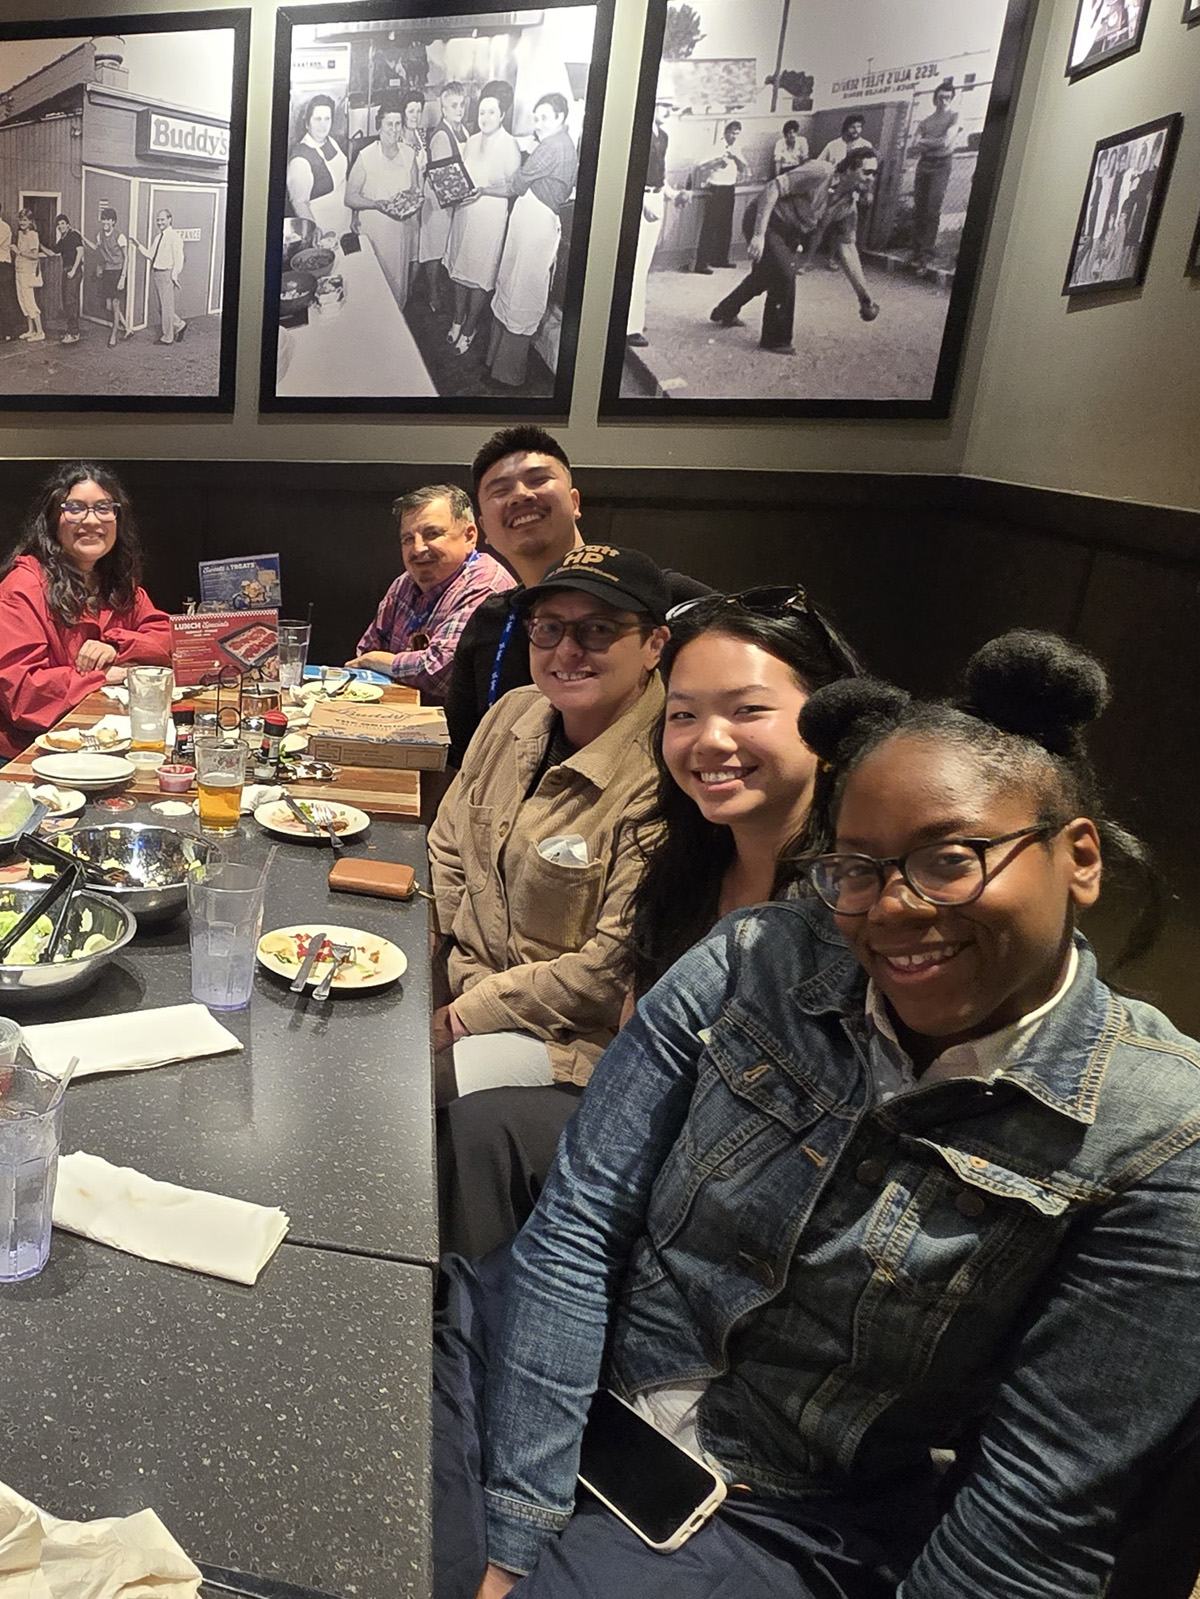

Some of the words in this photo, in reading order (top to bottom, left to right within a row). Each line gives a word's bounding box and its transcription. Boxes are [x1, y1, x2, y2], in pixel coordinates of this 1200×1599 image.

[153, 119, 227, 155] Buddy's
[563, 552, 604, 566] HP
[230, 562, 254, 570] TREATS
[174, 622, 200, 630] LUNCH
